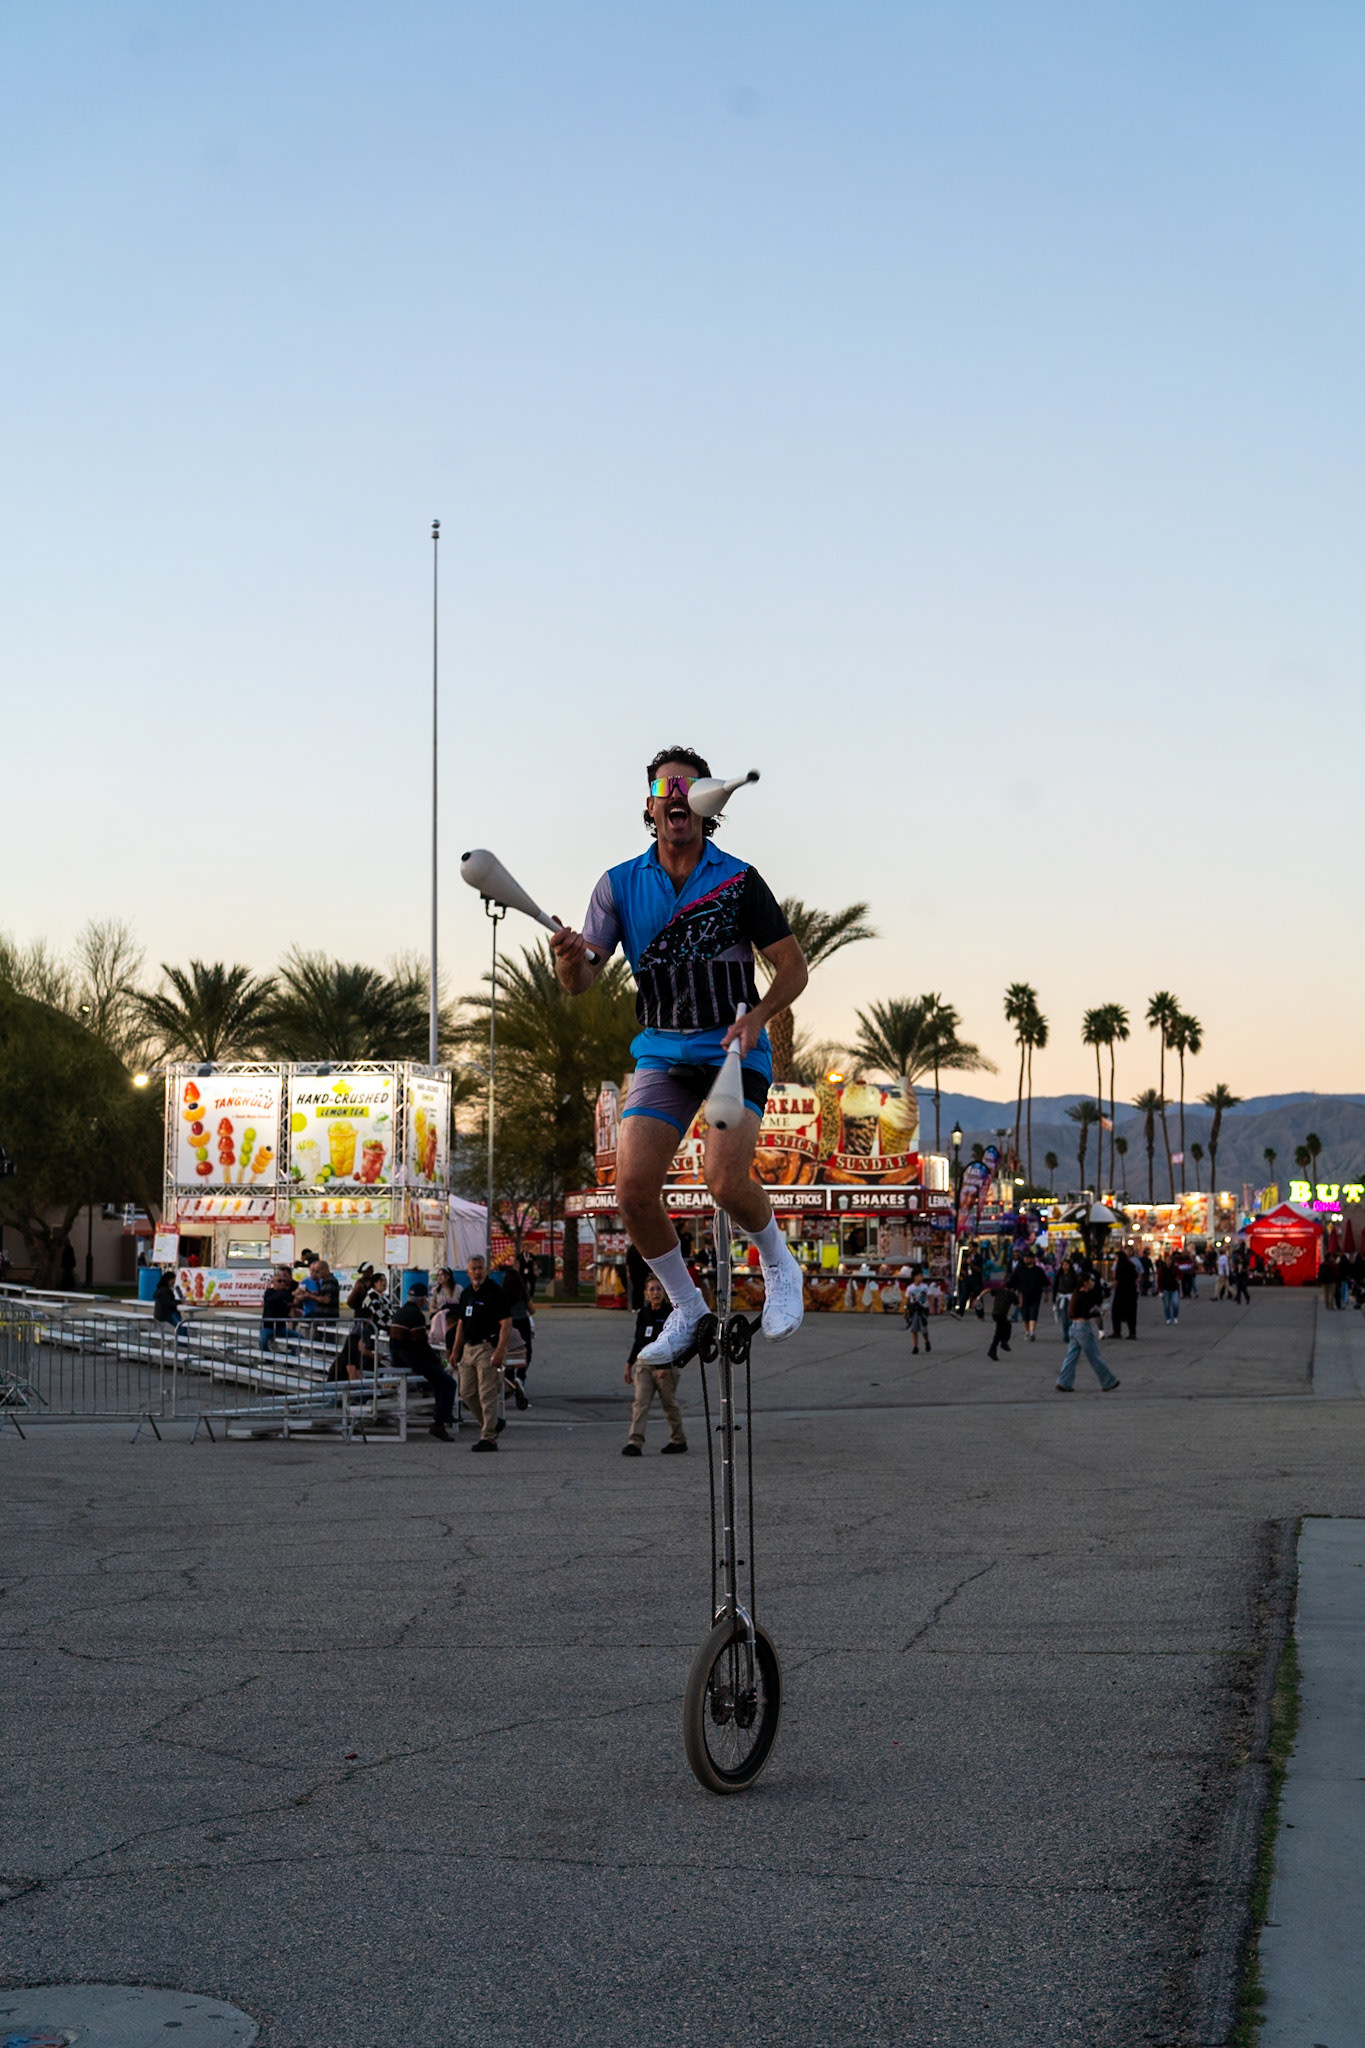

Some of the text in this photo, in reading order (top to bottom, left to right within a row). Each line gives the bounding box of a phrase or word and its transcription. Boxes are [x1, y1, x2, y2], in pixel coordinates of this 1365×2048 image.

[214, 1097, 274, 1109] TANGHULU
[296, 1093, 389, 1104] HAND-CRUSHED
[766, 1098, 815, 1114] REAM
[835, 1155, 908, 1170] SUNDAE
[1289, 1180, 1364, 1203] BUT
[666, 1193, 713, 1206] CREAM
[768, 1193, 823, 1205] TOAST STICKS
[851, 1194, 906, 1205] SHAKES
